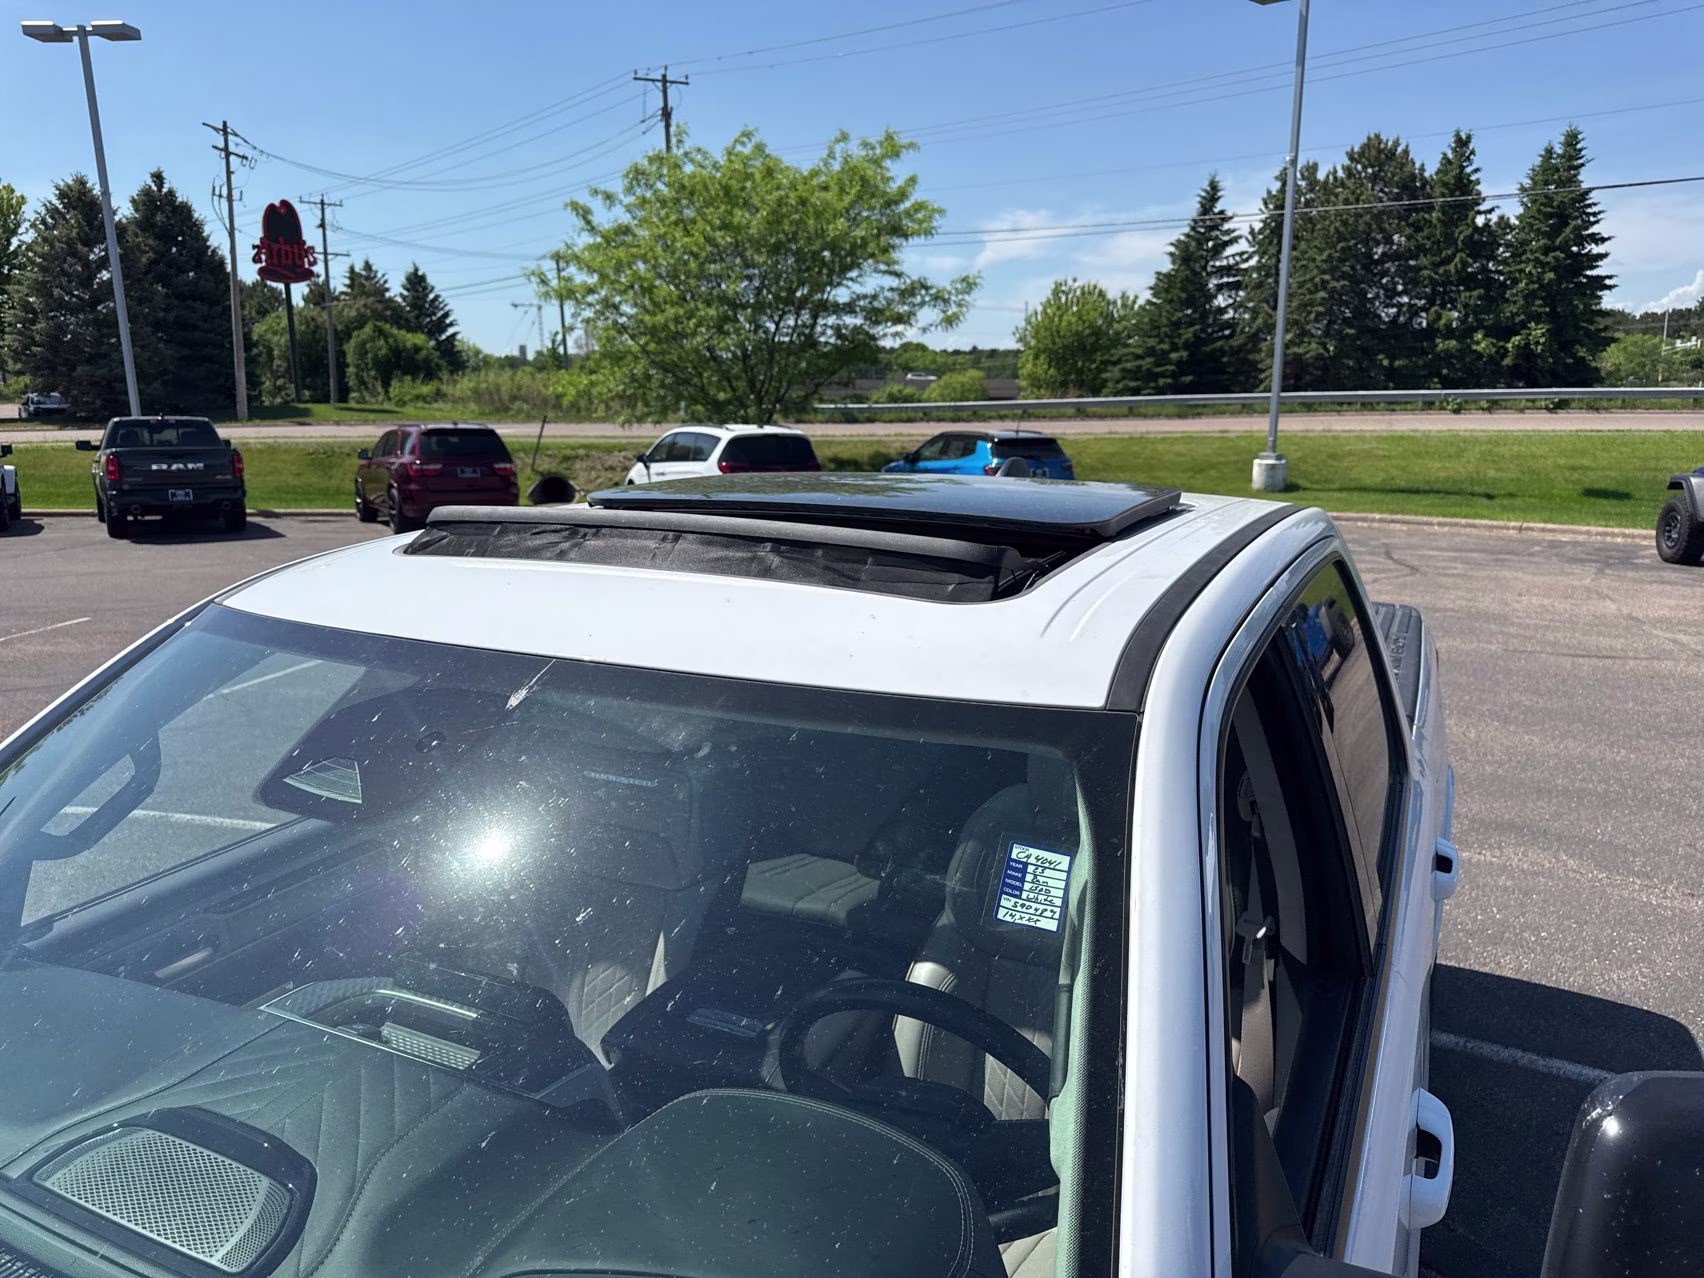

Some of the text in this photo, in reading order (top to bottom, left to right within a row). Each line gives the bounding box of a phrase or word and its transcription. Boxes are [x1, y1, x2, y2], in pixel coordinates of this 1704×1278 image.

[151, 462, 205, 471] RAM
[1009, 861, 1023, 869] YEAR
[1007, 870, 1023, 878] MAKE
[1005, 878, 1052, 895] MODEL 1500
[1003, 887, 1021, 896] COLOR
